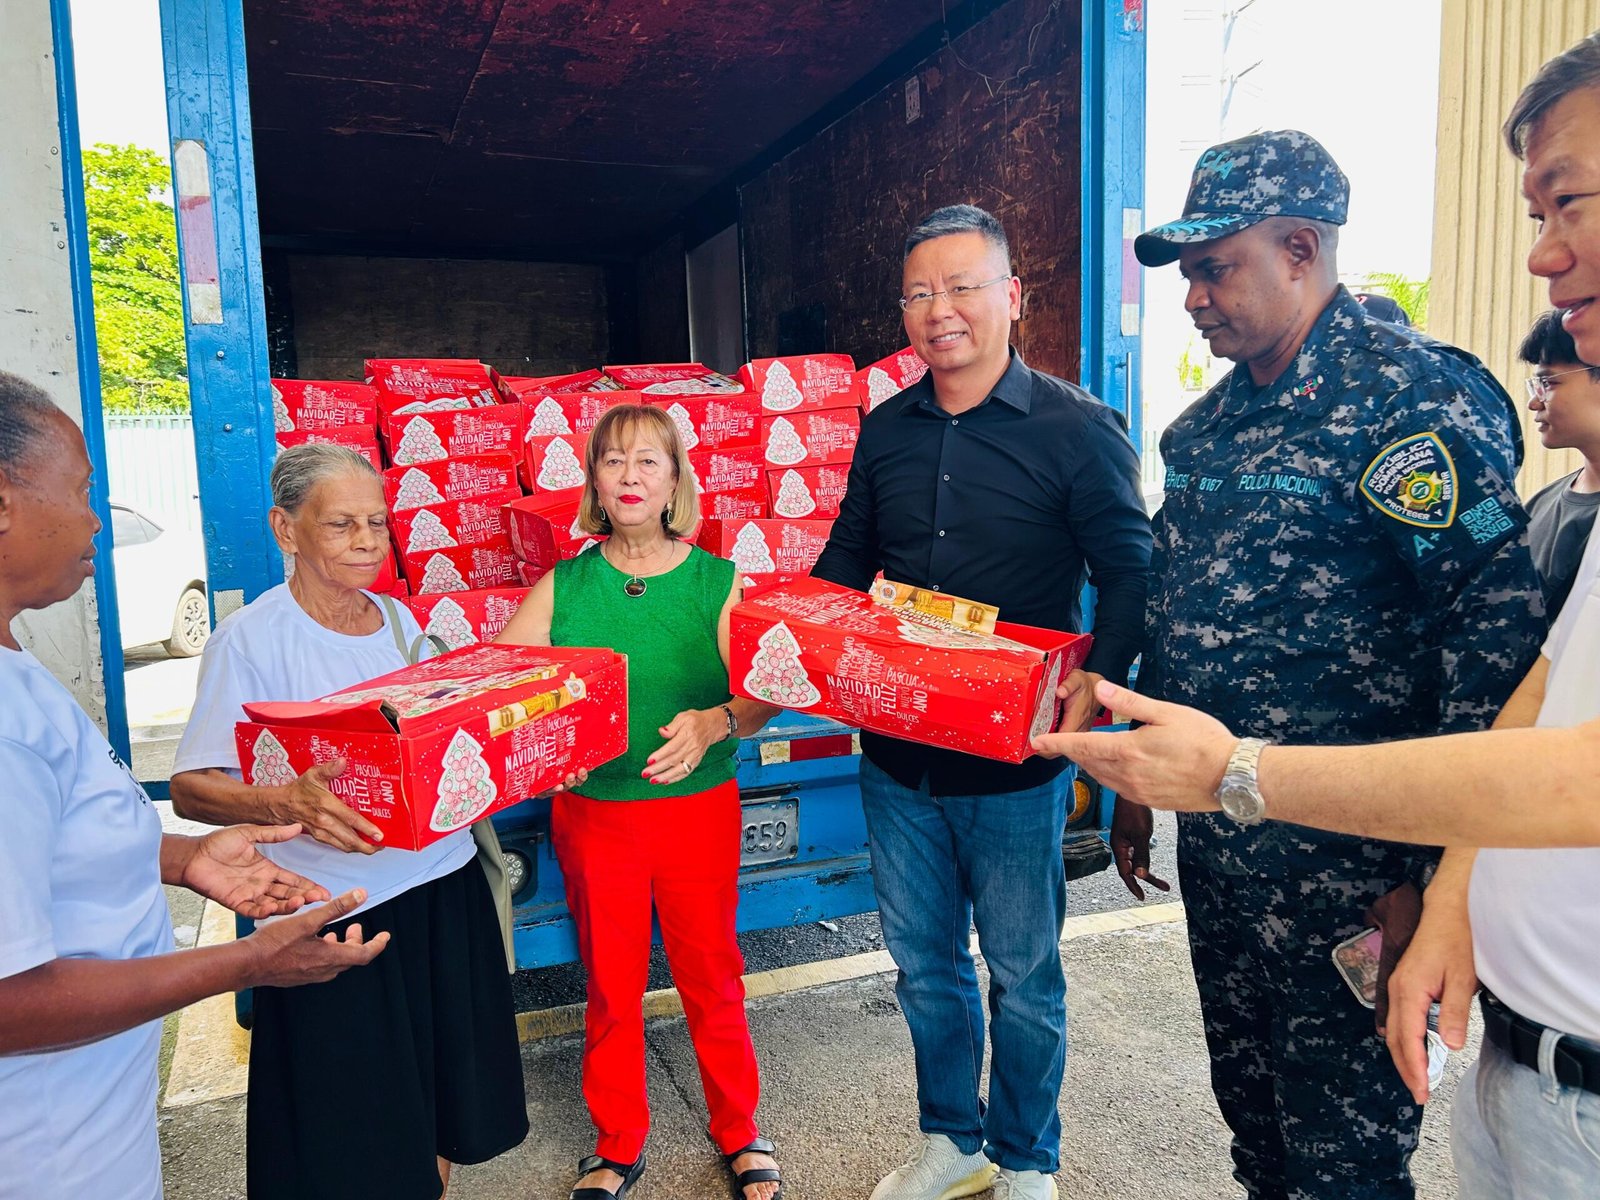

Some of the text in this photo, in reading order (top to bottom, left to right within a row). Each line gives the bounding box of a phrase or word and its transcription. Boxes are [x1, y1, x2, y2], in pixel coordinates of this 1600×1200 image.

[801, 378, 830, 389] NAVIDAD
[338, 401, 358, 409] PASCUA
[297, 408, 335, 420] NAVIDAD
[700, 421, 731, 432] NAVIDAD
[730, 418, 739, 436] FELIZ
[449, 434, 484, 445] NAVIDAD
[484, 430, 494, 449] FELIZ
[806, 433, 835, 444] NAVIDAD
[1367, 440, 1434, 488] REPÚBLICA
[1374, 449, 1434, 493] DOMINICANA
[1402, 458, 1436, 474] NACIONAL
[445, 480, 480, 492] NAVIDAD
[706, 473, 736, 484] NAVIDAD
[1200, 477, 1224, 492] 8167
[1272, 474, 1322, 497] NACIONAL
[815, 487, 842, 496] NAVIDAD
[1384, 498, 1430, 520] PROTEGER
[1441, 471, 1452, 500] SERVIR
[456, 519, 491, 535] NAVIDAD
[776, 547, 809, 558] NAVIDAD
[1412, 532, 1440, 557] A+
[468, 566, 503, 580] NAVIDAD
[838, 653, 852, 678] NUEVO
[868, 655, 885, 684] XMAS
[885, 669, 918, 687] PASCUA
[826, 674, 881, 699] NAVIDAD
[880, 682, 896, 716] FELIZ
[896, 711, 919, 723] DULCES
[505, 741, 546, 773] NAVIDAD
[545, 733, 556, 768] FELIZ
[355, 763, 380, 778] PASCUA
[354, 777, 372, 813] FELIZ
[371, 807, 392, 819] DULCES
